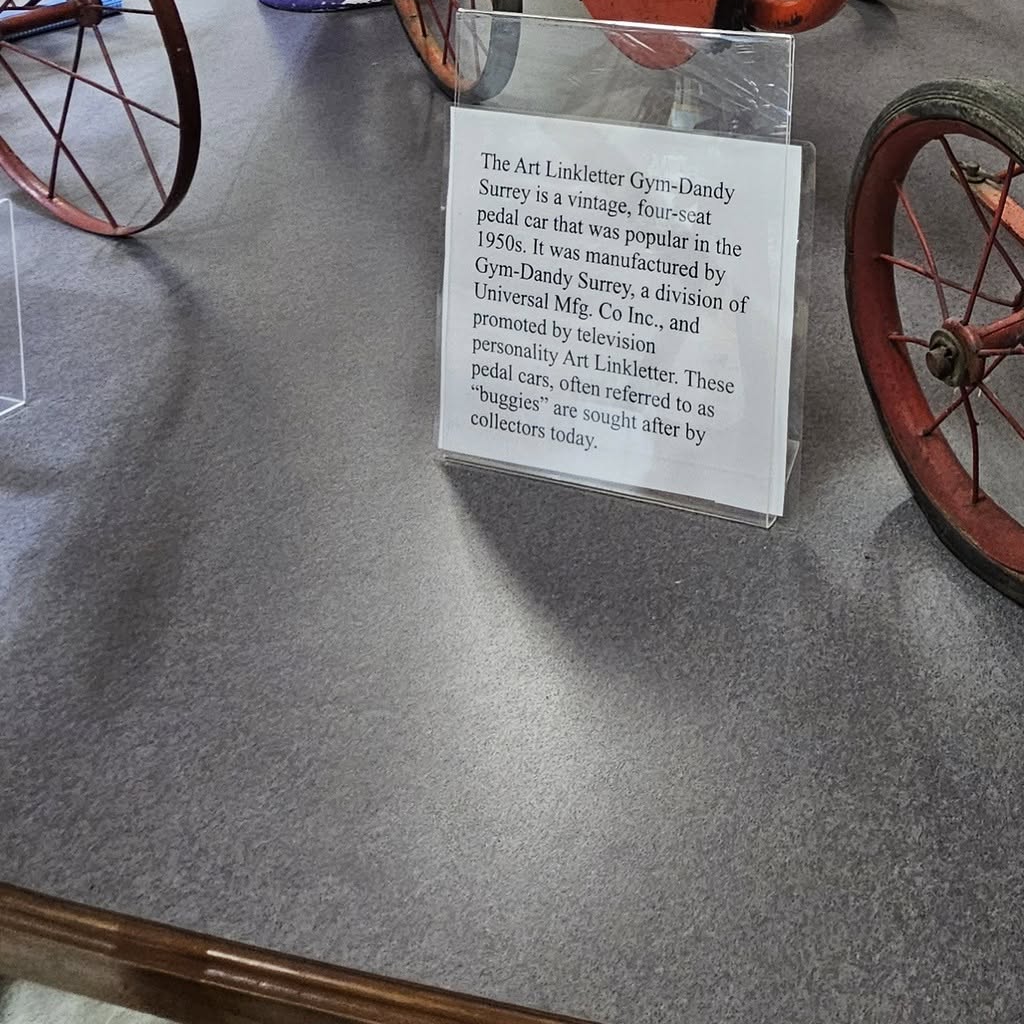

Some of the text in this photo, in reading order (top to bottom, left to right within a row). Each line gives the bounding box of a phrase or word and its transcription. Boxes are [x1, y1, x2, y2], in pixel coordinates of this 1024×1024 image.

[479, 180, 712, 226] Surrey is a vintage, four-seat
[481, 151, 736, 204] The Art Linkletter Gym-Dandy
[477, 206, 742, 258] pedal car that was popular in the
[477, 230, 726, 286] 1950s. It was manufactured by
[473, 282, 700, 334] Universal Mfg. Co Inc., and
[475, 256, 749, 314] Gym-Dandy Surrey, a division of
[473, 310, 656, 354] promoted by television
[472, 336, 735, 395] personality Art Linkletter. These
[472, 360, 715, 418] pedal cars, often referred to as
[471, 411, 598, 450] collectors today.
[553, 401, 578, 419] are
[583, 406, 637, 432] sought
[642, 416, 680, 438] after
[685, 424, 706, 446] by
